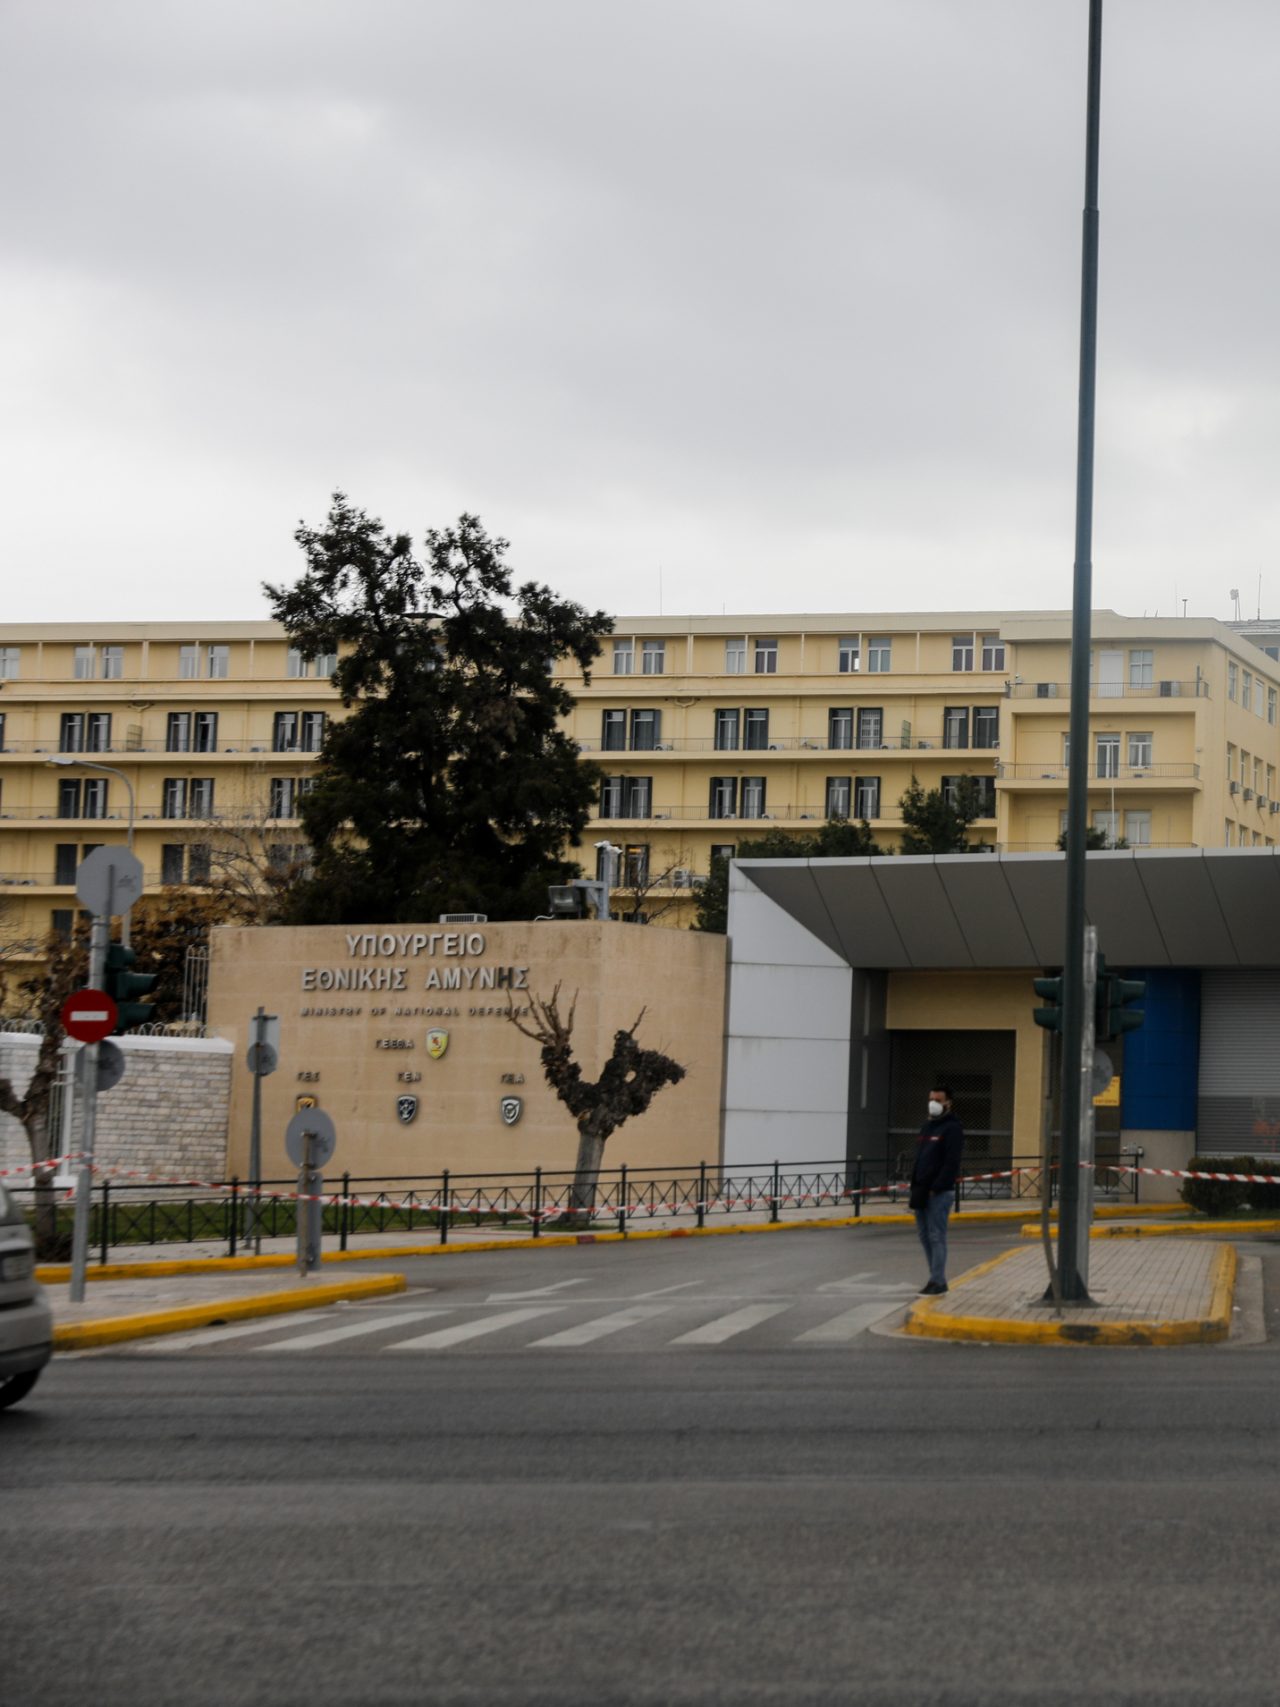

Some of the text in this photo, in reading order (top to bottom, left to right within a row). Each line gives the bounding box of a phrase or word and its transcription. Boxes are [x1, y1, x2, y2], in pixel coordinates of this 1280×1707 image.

[346, 933, 485, 956] ΥΠΟΥΡΓΕΙΟ
[303, 966, 529, 991] ΕΘΝΙΚΗΣ ΑΜΥΝΗΣ
[301, 1007, 362, 1017] MINISTRY
[370, 1007, 386, 1017] OF
[394, 1007, 460, 1017] NATIONAL
